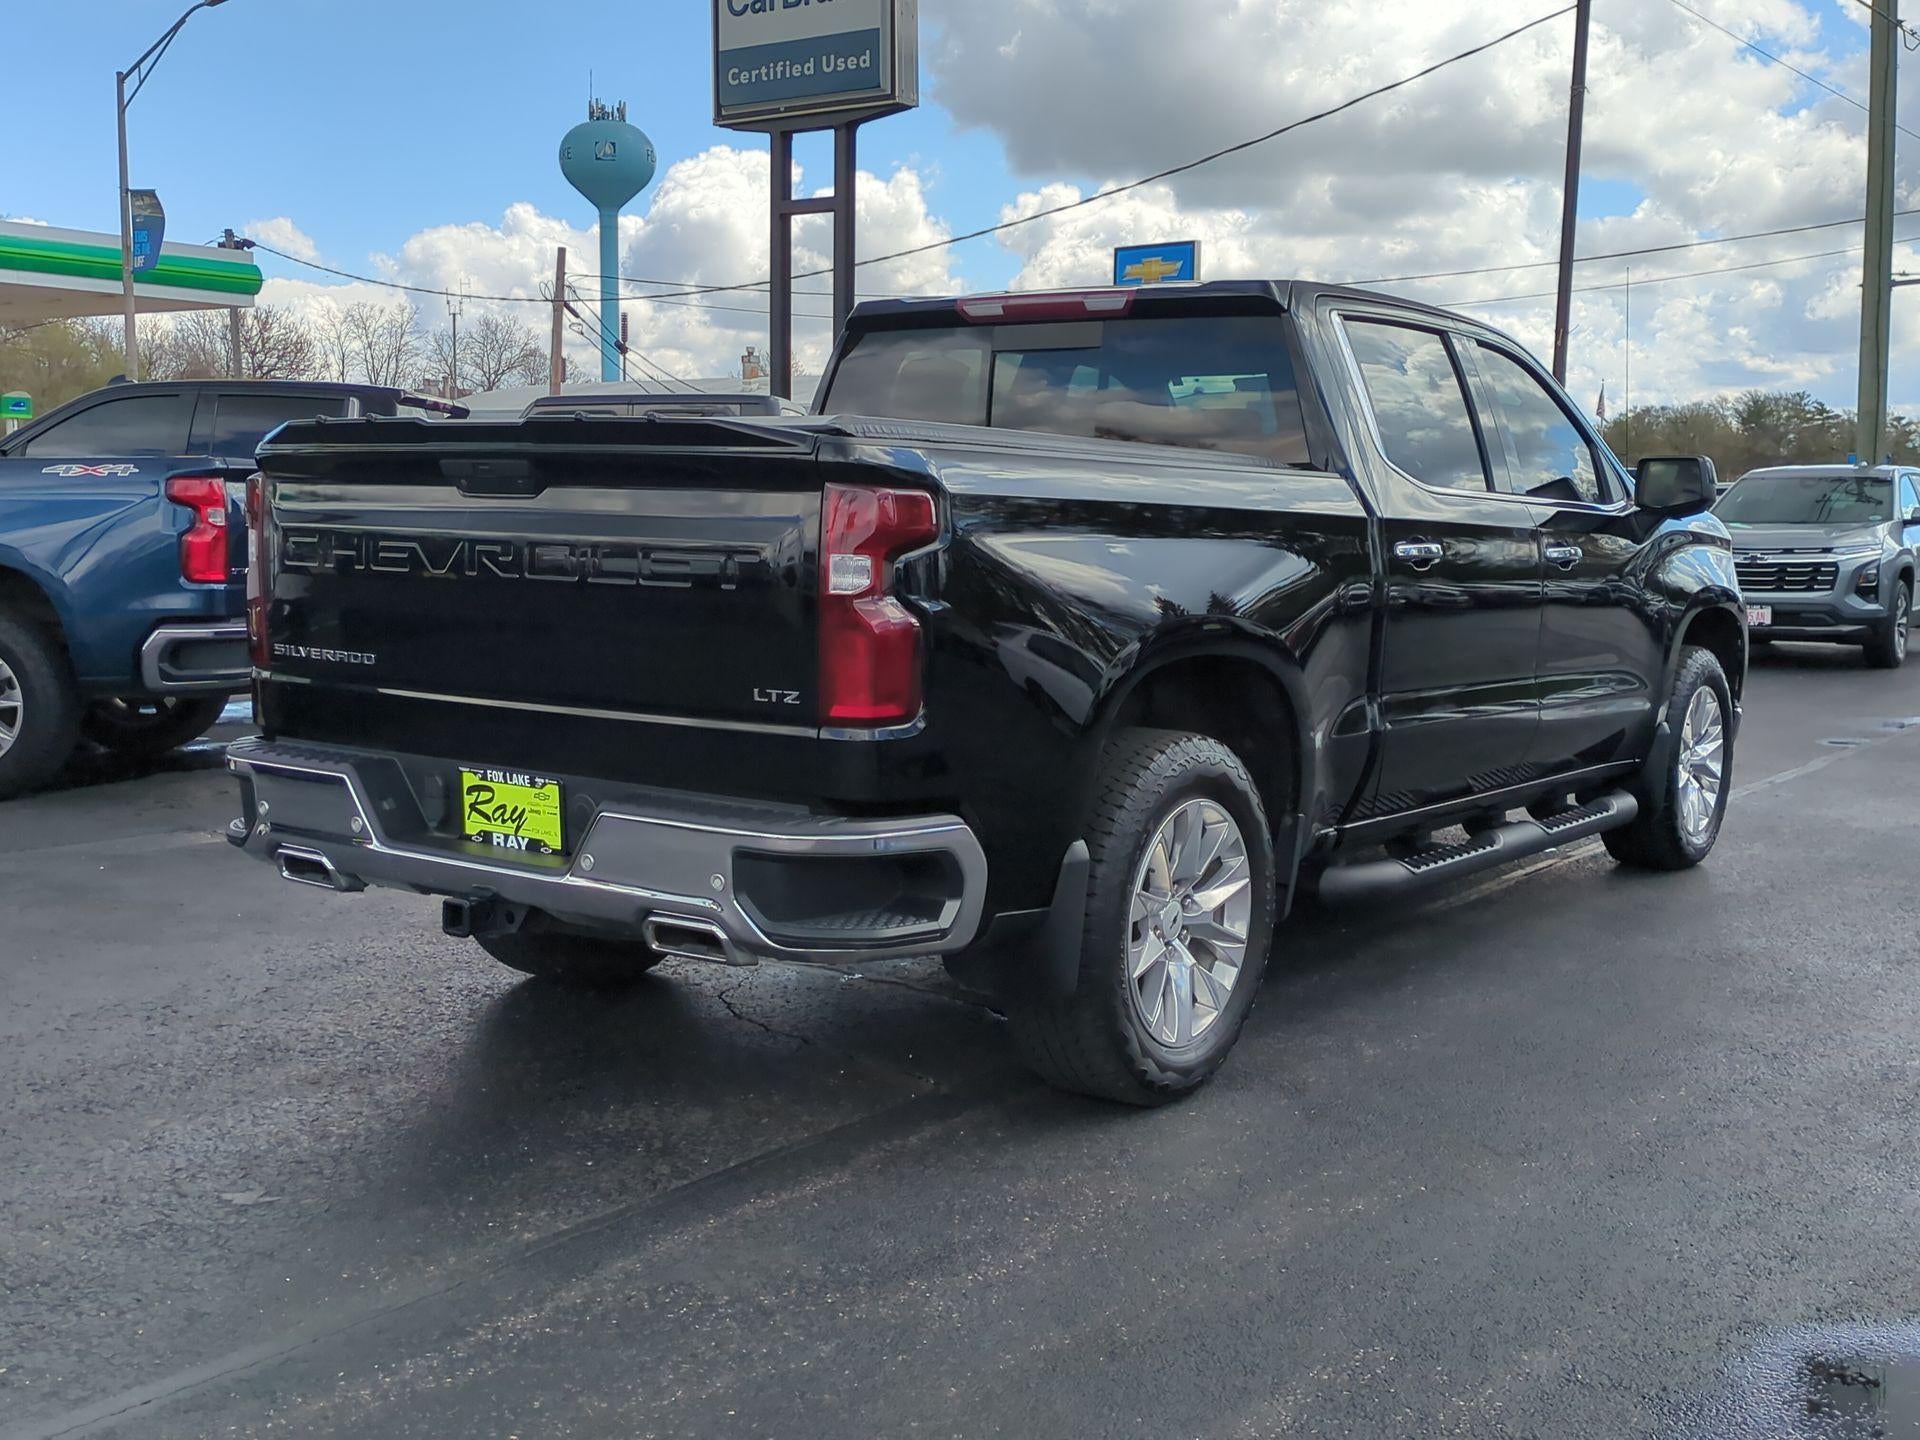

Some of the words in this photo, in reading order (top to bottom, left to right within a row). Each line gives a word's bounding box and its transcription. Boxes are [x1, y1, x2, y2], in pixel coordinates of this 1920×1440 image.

[727, 0, 832, 16] Car
[728, 57, 814, 85] Certified
[821, 50, 871, 73] Used
[283, 534, 761, 590] CHEVROLET
[273, 643, 376, 665] SILVERADO
[753, 688, 800, 704] LTZ
[486, 769, 505, 784] FOX
[506, 772, 531, 787] LAKE
[466, 784, 528, 836] Ray
[492, 832, 530, 851] RAY
